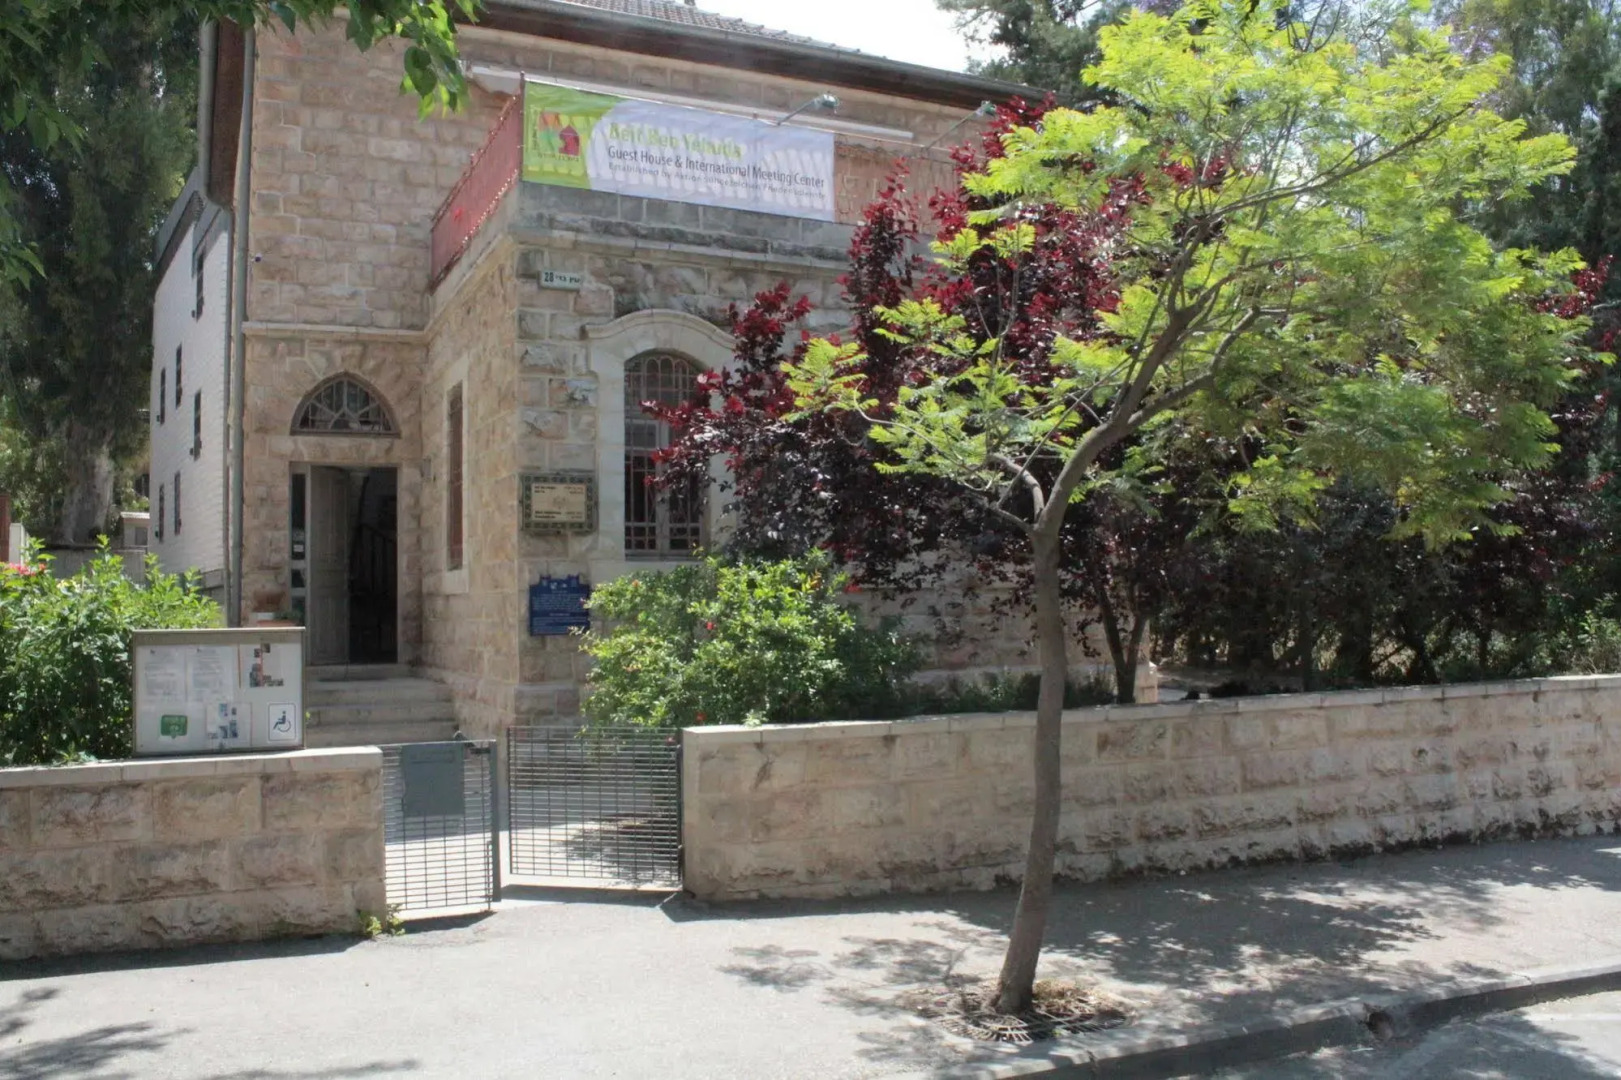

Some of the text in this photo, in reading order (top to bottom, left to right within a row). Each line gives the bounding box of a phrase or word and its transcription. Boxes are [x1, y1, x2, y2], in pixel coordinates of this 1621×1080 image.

[608, 146, 825, 188] Guest House & International Meeting Center
[544, 271, 554, 283] 28
